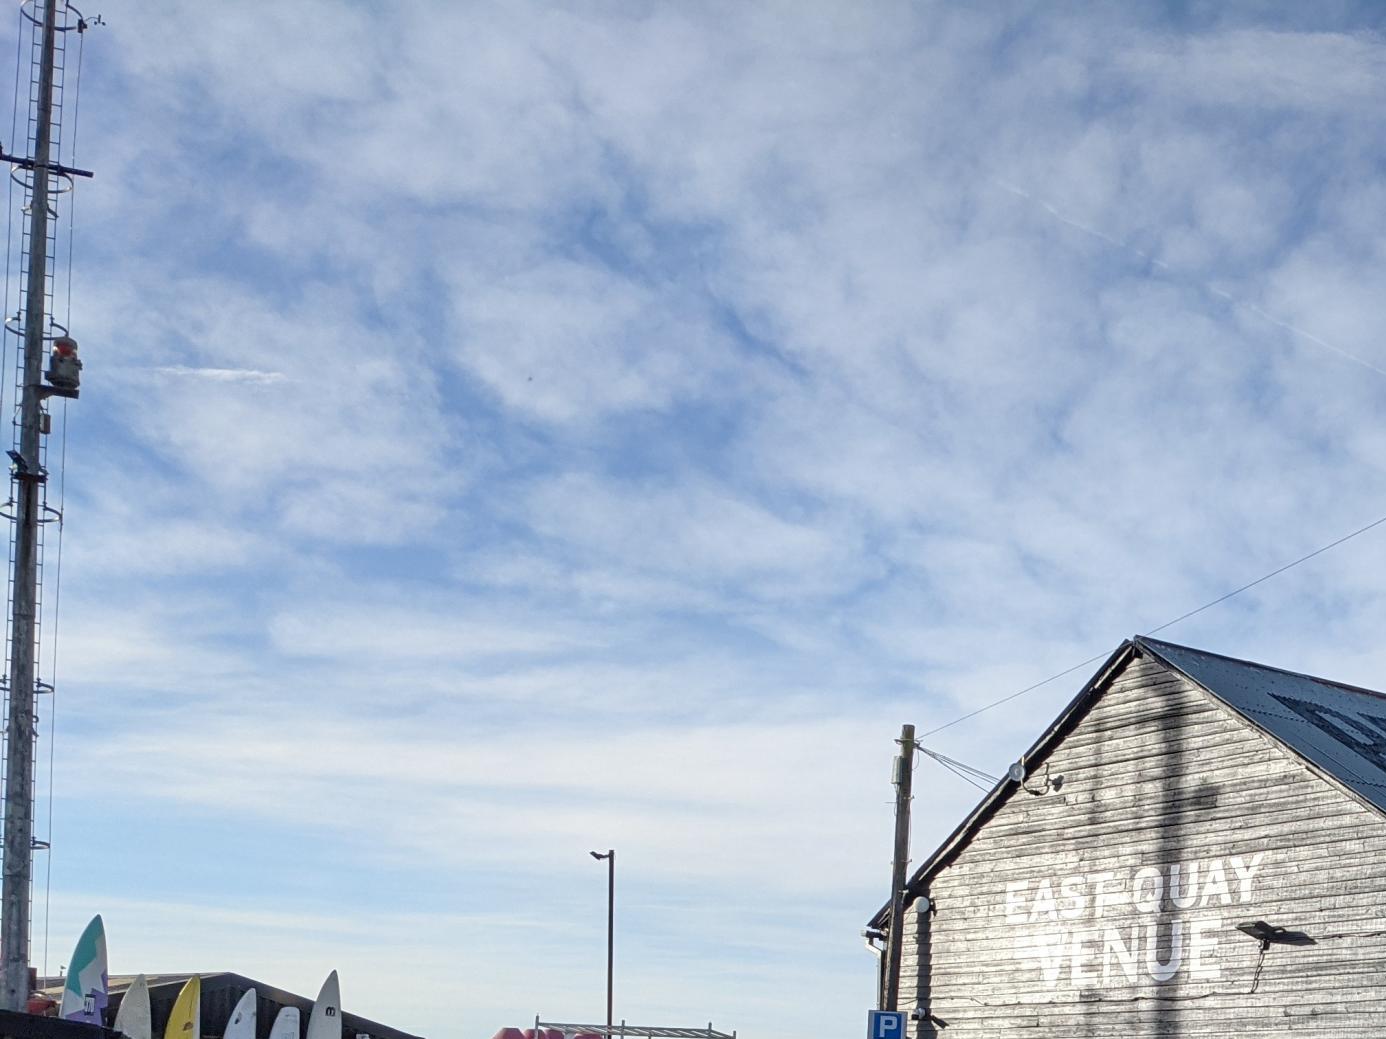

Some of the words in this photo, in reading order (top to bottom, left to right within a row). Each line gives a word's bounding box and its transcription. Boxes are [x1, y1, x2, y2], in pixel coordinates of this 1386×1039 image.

[1004, 870, 1116, 924] EAST
[1132, 853, 1265, 914] QUAY
[1033, 917, 1223, 988] VENUE
[879, 1015, 898, 1038] P
